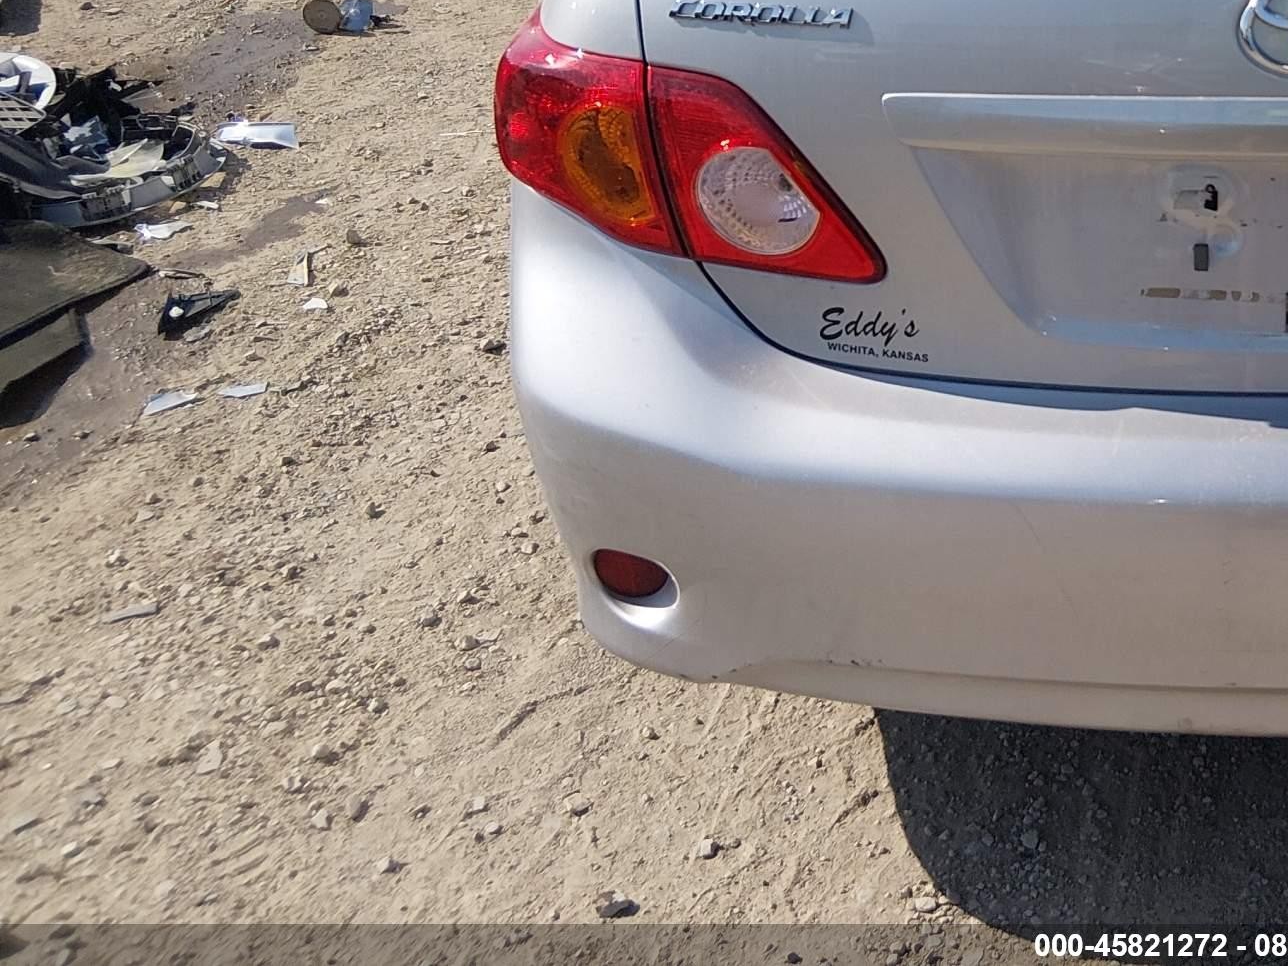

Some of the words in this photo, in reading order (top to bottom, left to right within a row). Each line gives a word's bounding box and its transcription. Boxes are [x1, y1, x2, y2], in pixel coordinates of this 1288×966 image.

[819, 306, 920, 347] Eddy's
[827, 341, 879, 358] WICHITA,
[882, 348, 929, 363] KANSAS
